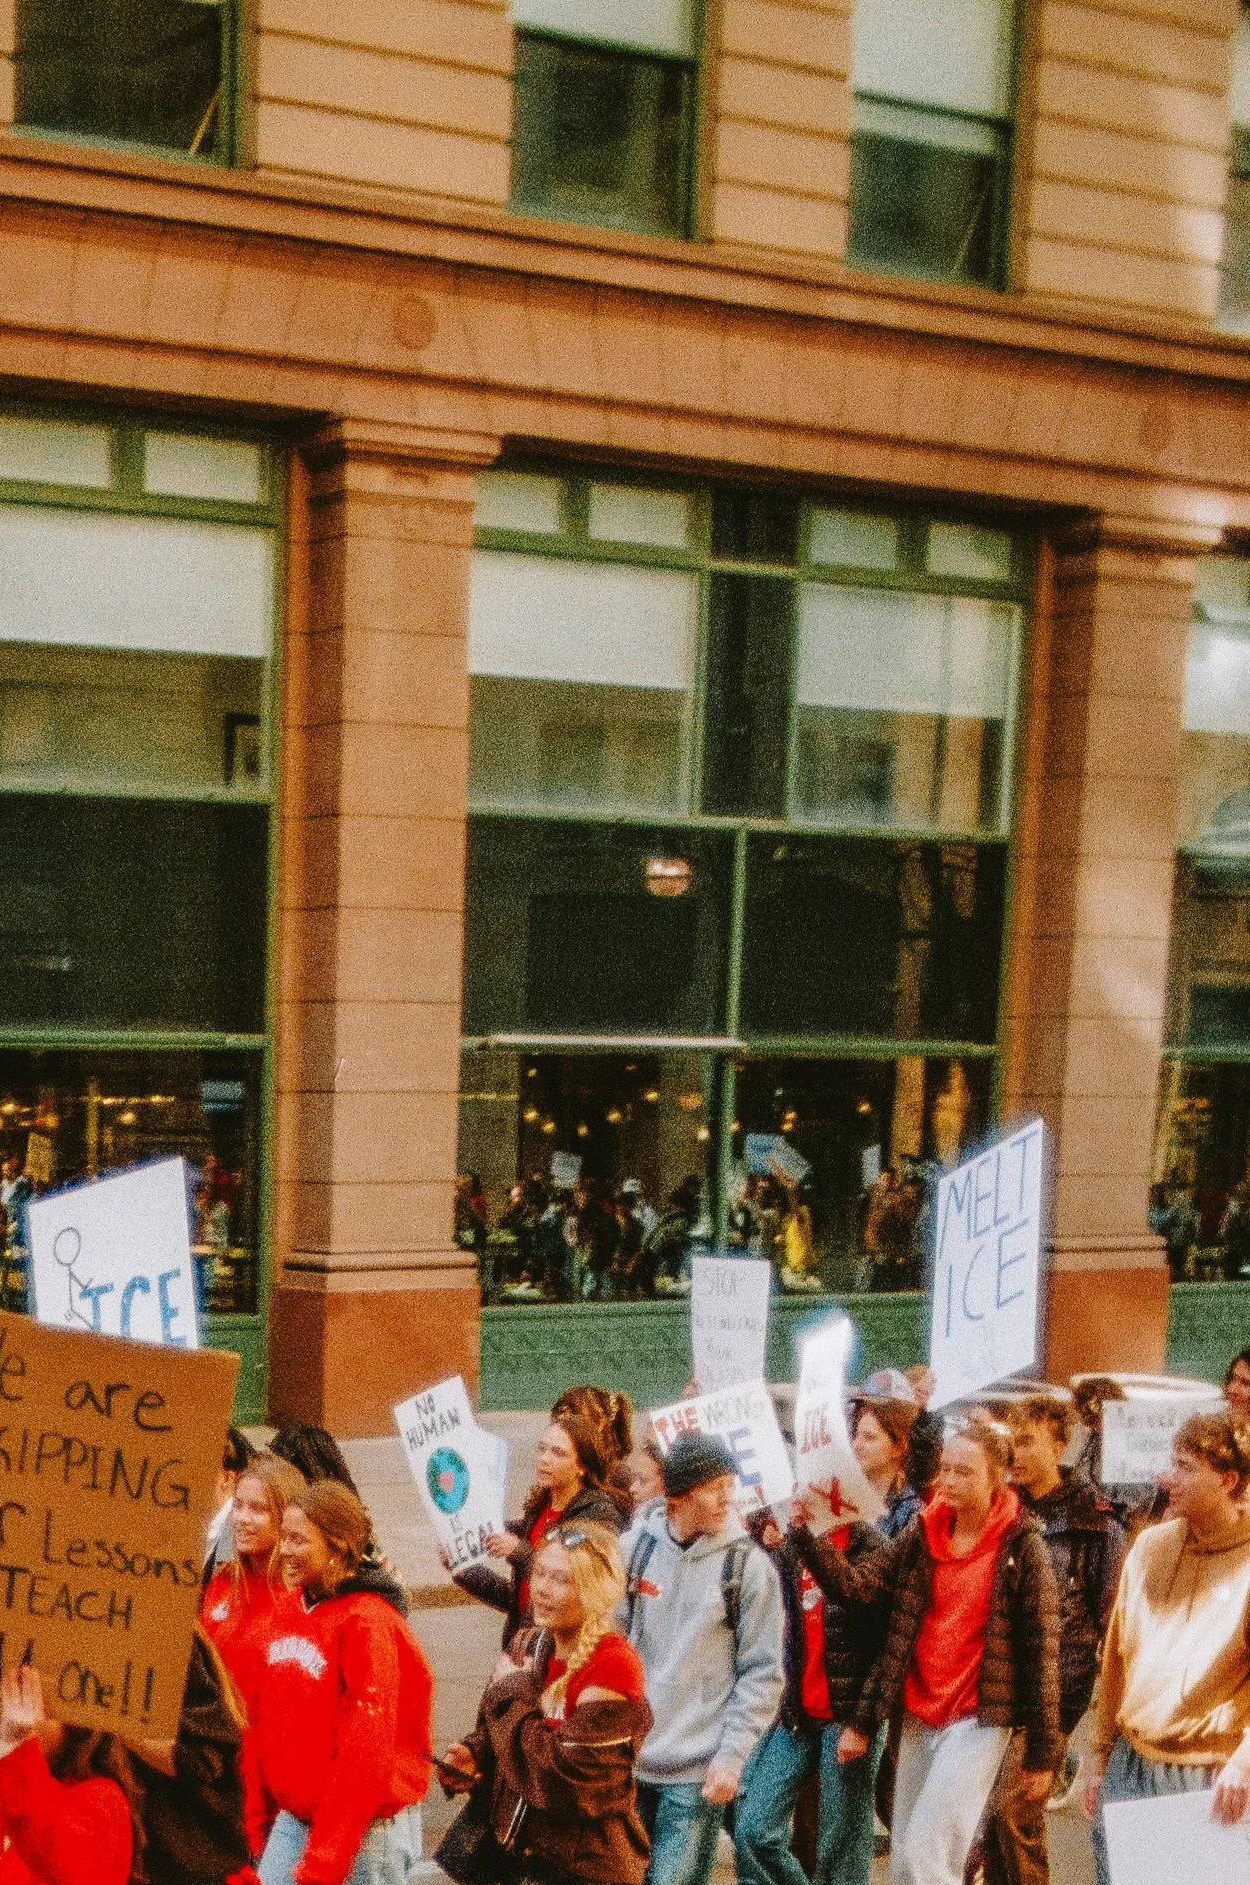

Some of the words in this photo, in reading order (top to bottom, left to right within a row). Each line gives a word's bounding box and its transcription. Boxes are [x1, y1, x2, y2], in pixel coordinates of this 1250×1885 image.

[939, 1129, 1039, 1260] MELT
[79, 1268, 187, 1347] ICE
[945, 1218, 1029, 1338] ICE
[65, 1380, 173, 1432] are
[406, 1408, 461, 1451] HUMAN
[414, 1393, 436, 1421] NO
